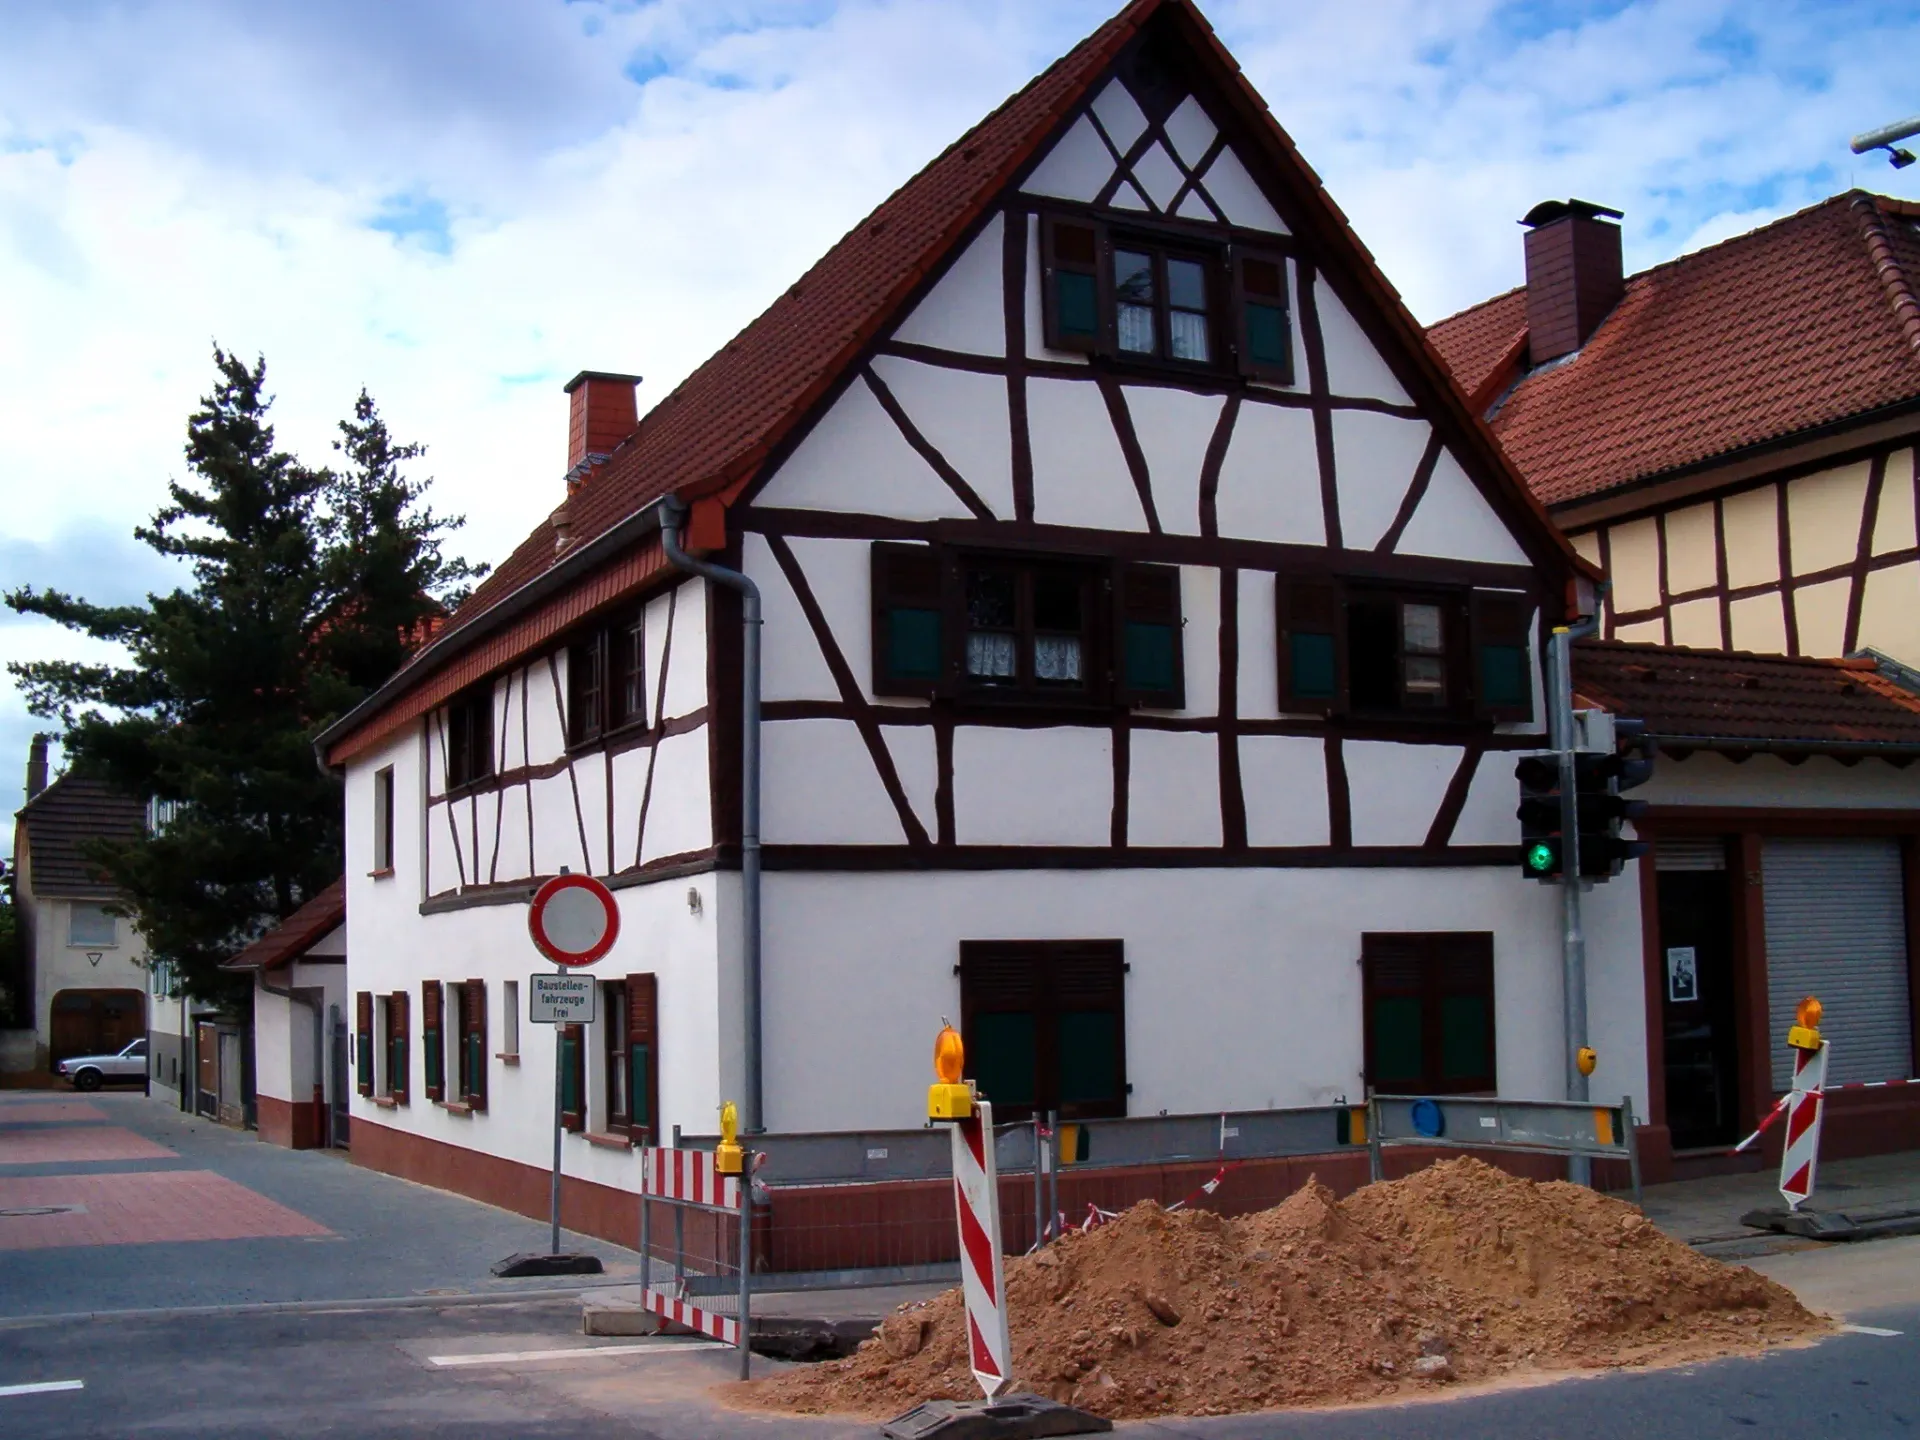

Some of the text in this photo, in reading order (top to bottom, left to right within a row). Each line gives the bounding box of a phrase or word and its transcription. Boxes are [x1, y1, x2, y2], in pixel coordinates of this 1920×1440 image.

[537, 979, 589, 991] Baustellen-
[541, 993, 585, 1006] fahrzeuge
[553, 1006, 569, 1018] frei
